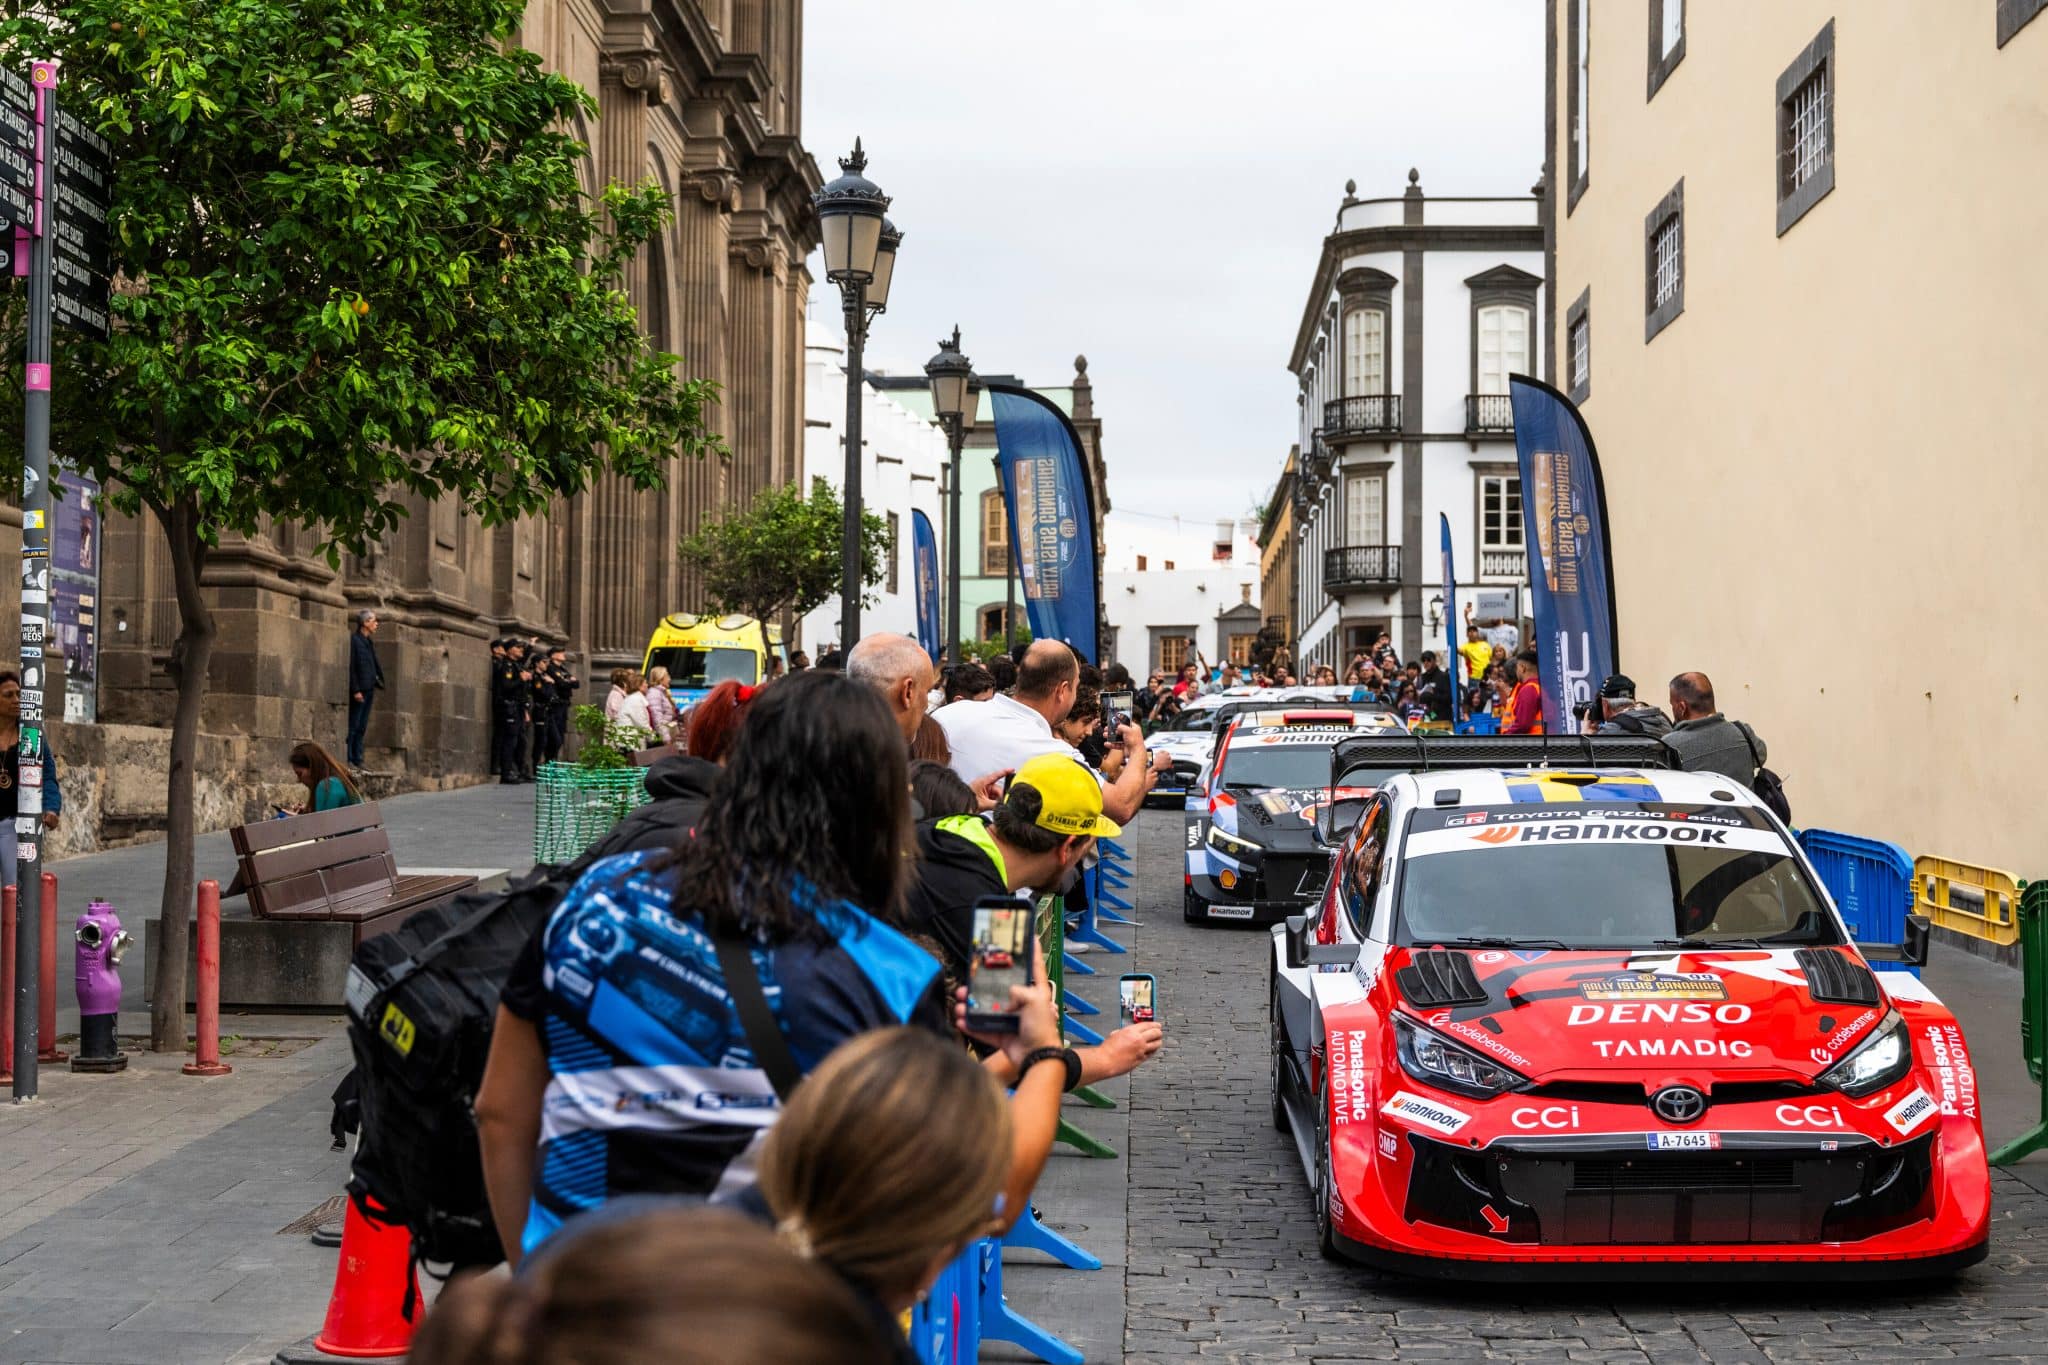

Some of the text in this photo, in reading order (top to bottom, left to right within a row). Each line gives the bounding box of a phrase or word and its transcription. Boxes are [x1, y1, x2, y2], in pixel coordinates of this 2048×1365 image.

[61, 110, 80, 136] CATEDRAL
[60, 145, 73, 168] PLAZA
[75, 156, 80, 173] DE
[3, 184, 9, 201] DE
[60, 183, 73, 204] CASAS
[59, 220, 83, 247] ARTE SACRO
[1493, 810, 1580, 820] TOYOTA
[1587, 810, 1664, 818] GAZOO
[1670, 812, 1742, 826] Racing
[1583, 982, 1721, 991] RALLY ISLAS CANARIAS
[1567, 1003, 1752, 1026] DENSO
[1827, 1010, 1876, 1050] codebeamer
[1592, 1039, 1753, 1057] TAMADIC
[1331, 1030, 1348, 1127] AUTOMOTIVE
[1349, 1030, 1366, 1121] Panasonic
[1925, 1025, 1959, 1116] Panasonic
[1943, 1025, 1976, 1118] AUTOMOTIVE
[1379, 1134, 1397, 1155] OMP
[1663, 1136, 1706, 1147] A-7645
